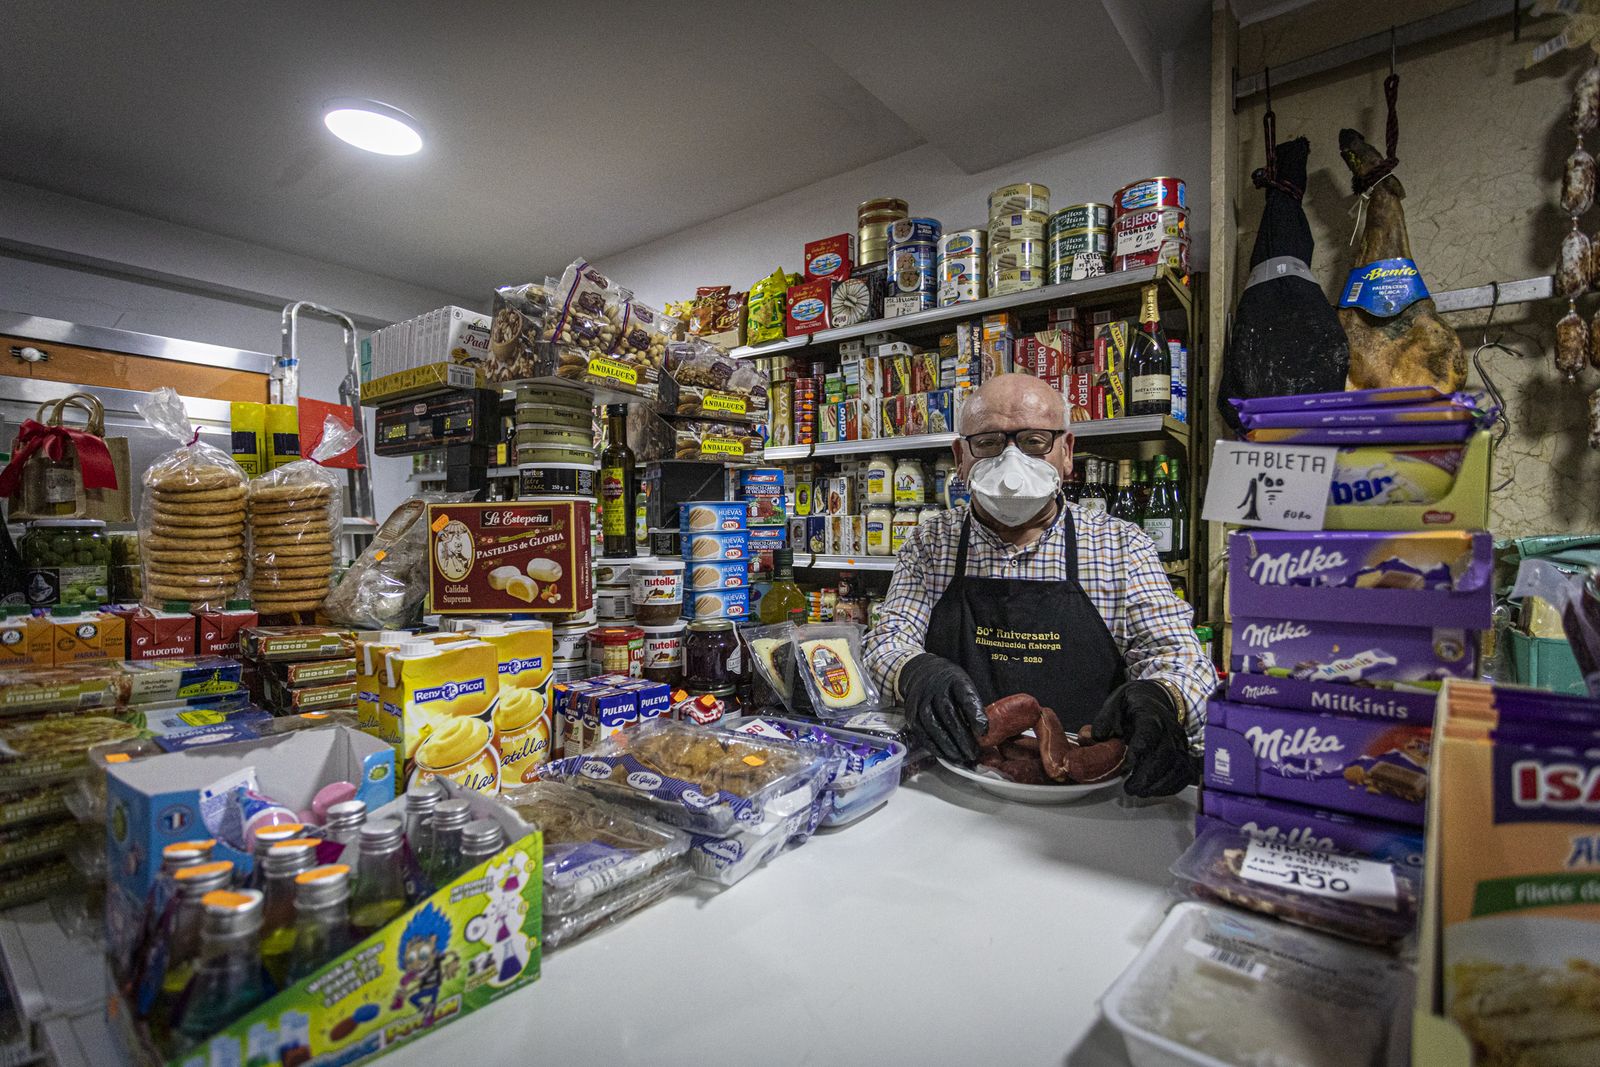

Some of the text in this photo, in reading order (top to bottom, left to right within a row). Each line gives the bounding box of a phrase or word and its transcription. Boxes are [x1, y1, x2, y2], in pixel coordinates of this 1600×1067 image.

[1121, 211, 1158, 230] TEJERO
[1361, 265, 1418, 281] Benito
[463, 334, 491, 350] Paell
[1037, 346, 1048, 378] TEJERO
[590, 363, 635, 381] ANDALUCES
[1078, 373, 1088, 406] TEJERO
[703, 400, 744, 410] ANDALUCES
[702, 444, 742, 452] ANDALUCES
[1230, 450, 1326, 475] TABLETA
[1331, 475, 1393, 505] bar
[484, 511, 549, 527] La Estepeña
[718, 508, 743, 516] HUEVAS
[476, 532, 564, 560] PASTELES de GLORIA
[1250, 546, 1348, 586] Milka
[444, 584, 469, 594] Calidad
[644, 576, 676, 587] nutella
[442, 594, 471, 604] Suprema
[996, 628, 1060, 641] Aniversario
[1242, 621, 1312, 649] Milka
[649, 640, 680, 650] nutella
[975, 637, 1027, 650] Alimentación
[521, 659, 541, 668] Picot
[991, 653, 1009, 661] 1970
[1321, 657, 1373, 677] Milkinis
[415, 681, 484, 701] Reny Picot
[1241, 684, 1279, 699] Milka
[641, 695, 669, 709] PULEVA
[1311, 691, 1409, 719] Milkinis
[602, 703, 635, 718] PULEVA
[1245, 726, 1346, 762] Milka
[582, 764, 590, 774] El
[631, 774, 640, 783] El
[1515, 882, 1575, 902] Filete
